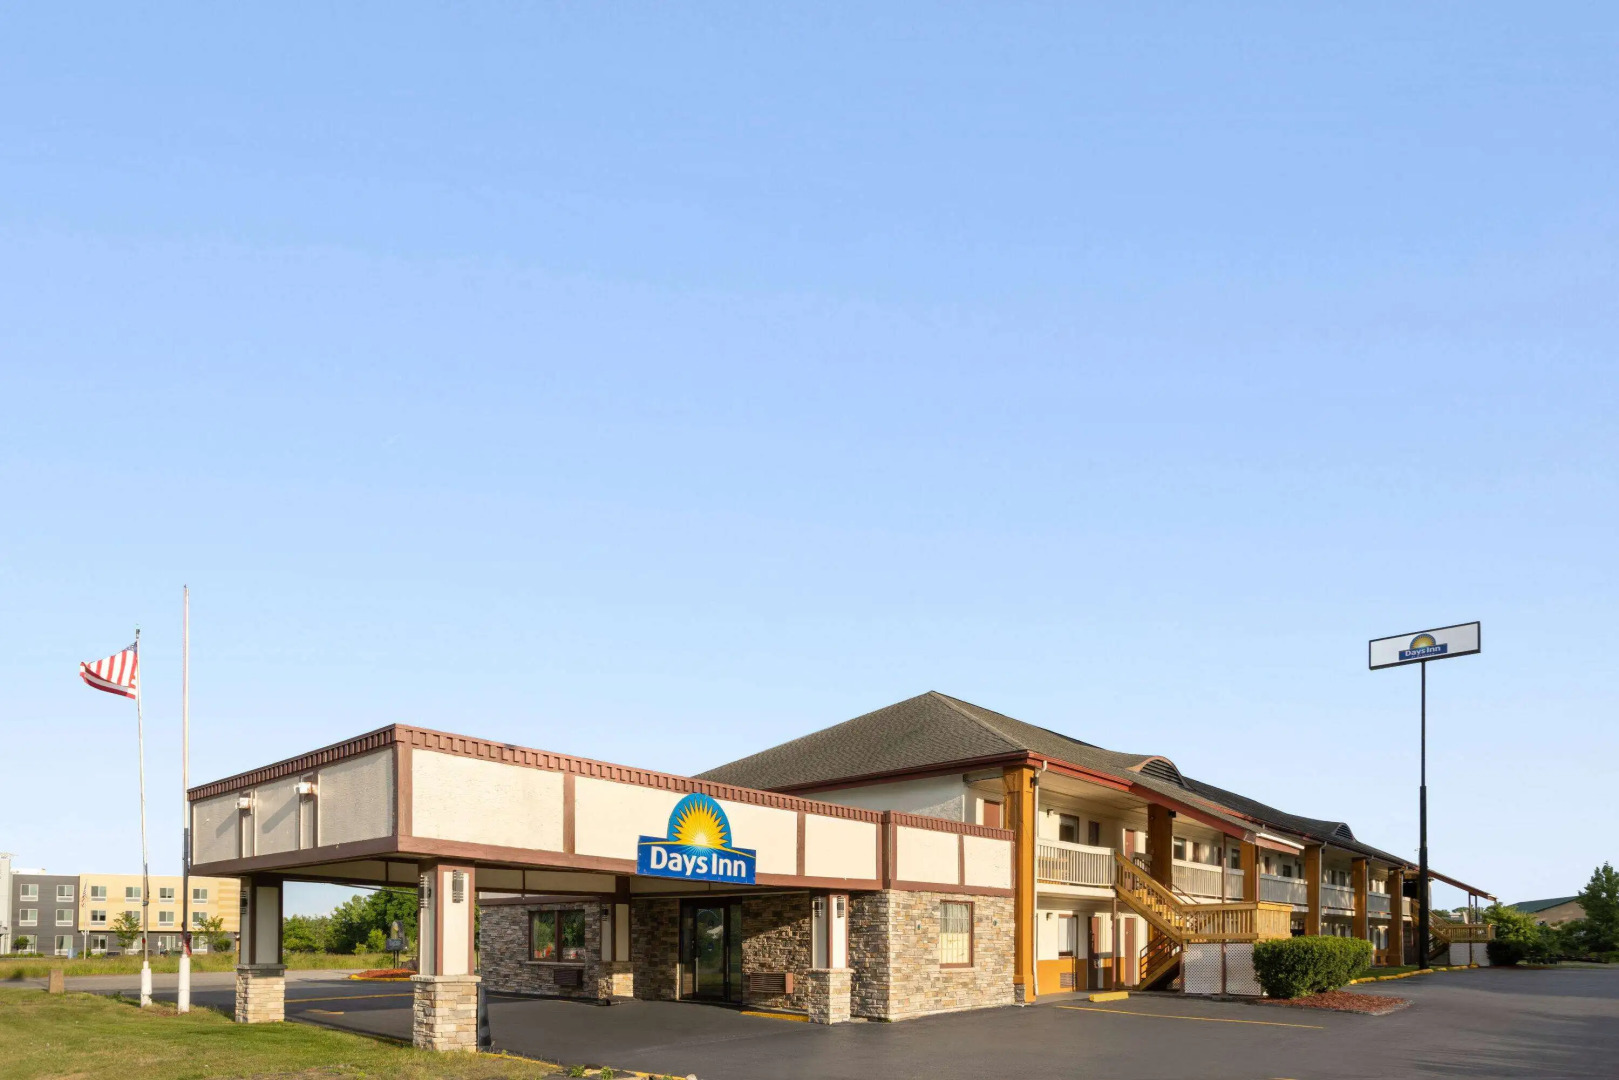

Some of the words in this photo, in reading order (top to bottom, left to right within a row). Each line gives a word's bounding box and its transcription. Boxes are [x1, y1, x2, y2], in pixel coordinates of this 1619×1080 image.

[1405, 648, 1426, 656] Days
[650, 845, 708, 876] Days
[711, 853, 746, 878] Inn
